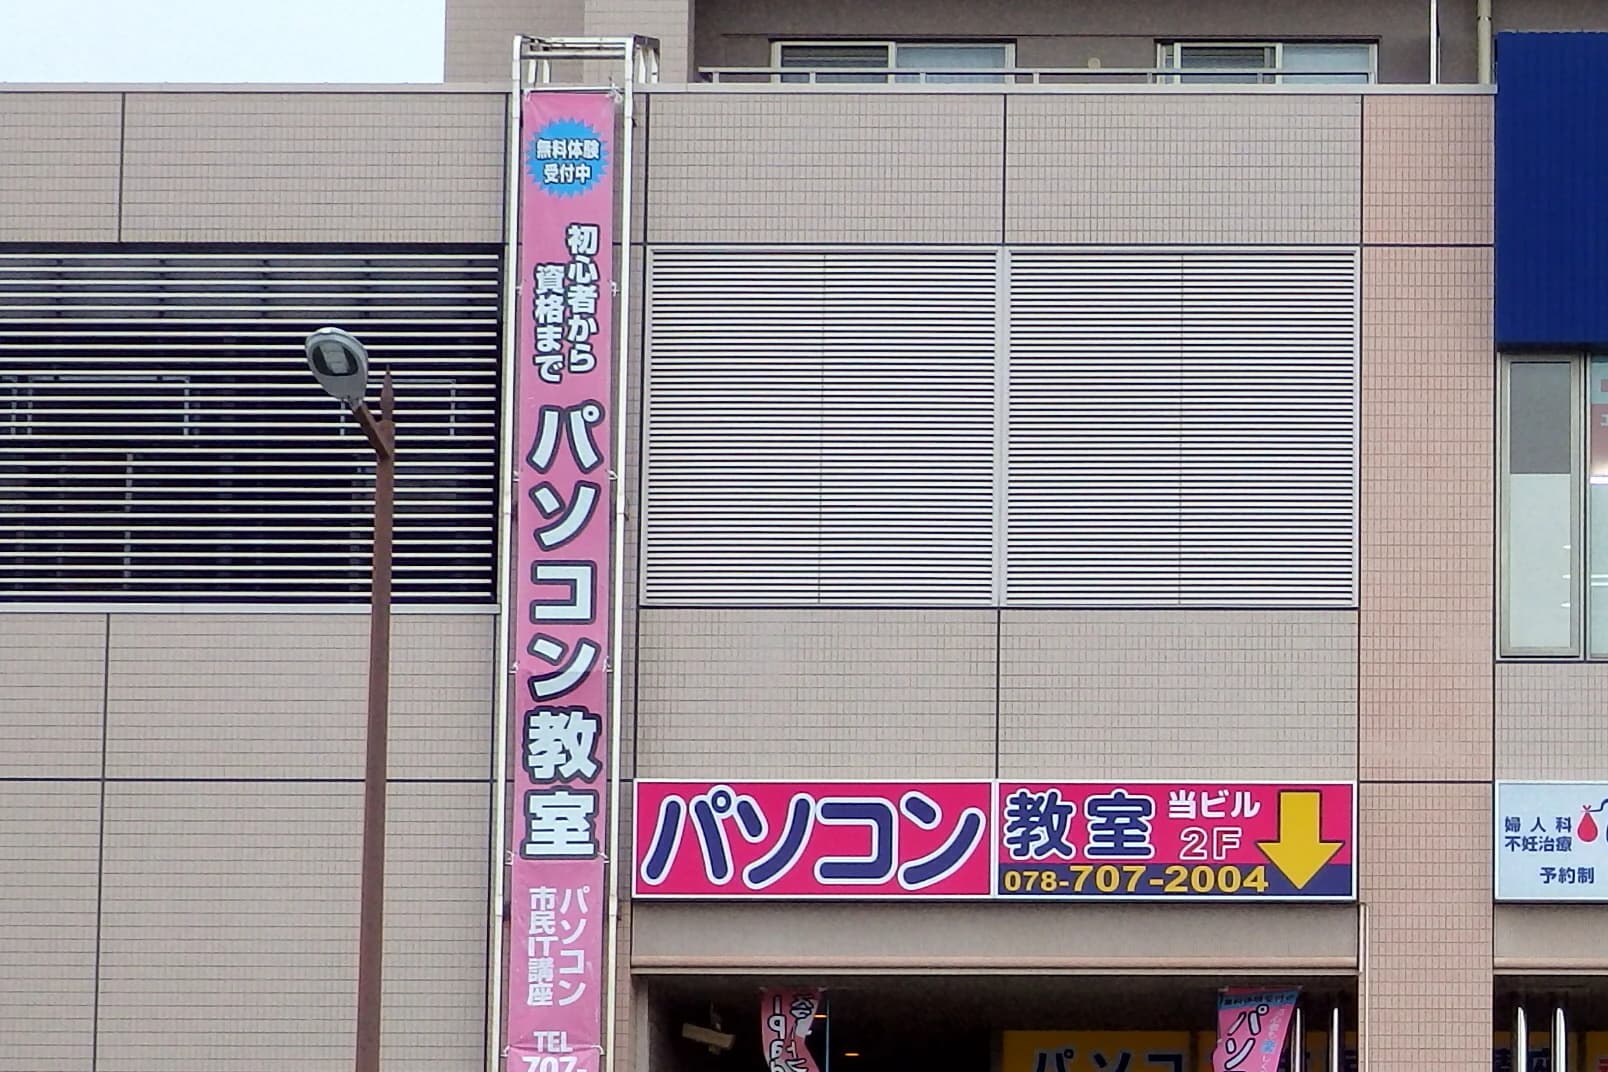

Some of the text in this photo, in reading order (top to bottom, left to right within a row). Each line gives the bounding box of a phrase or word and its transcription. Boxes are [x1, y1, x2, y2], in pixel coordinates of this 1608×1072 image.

[536, 139, 600, 160] 無料体験
[543, 163, 592, 184] 受付中
[567, 224, 599, 374] 初心者から
[535, 264, 564, 383] 資格まで
[521, 400, 605, 860] パソコン教室
[1168, 790, 1260, 820] 当ビル
[1179, 827, 1242, 861] 2F
[1504, 835, 1572, 852] 不妊治療
[1004, 865, 1269, 893] 078-707-2004
[1540, 867, 1594, 885] 予約制
[527, 886, 557, 1007] 市民IT講座
[560, 886, 591, 1006] パソコン
[534, 1031, 573, 1053] TEL
